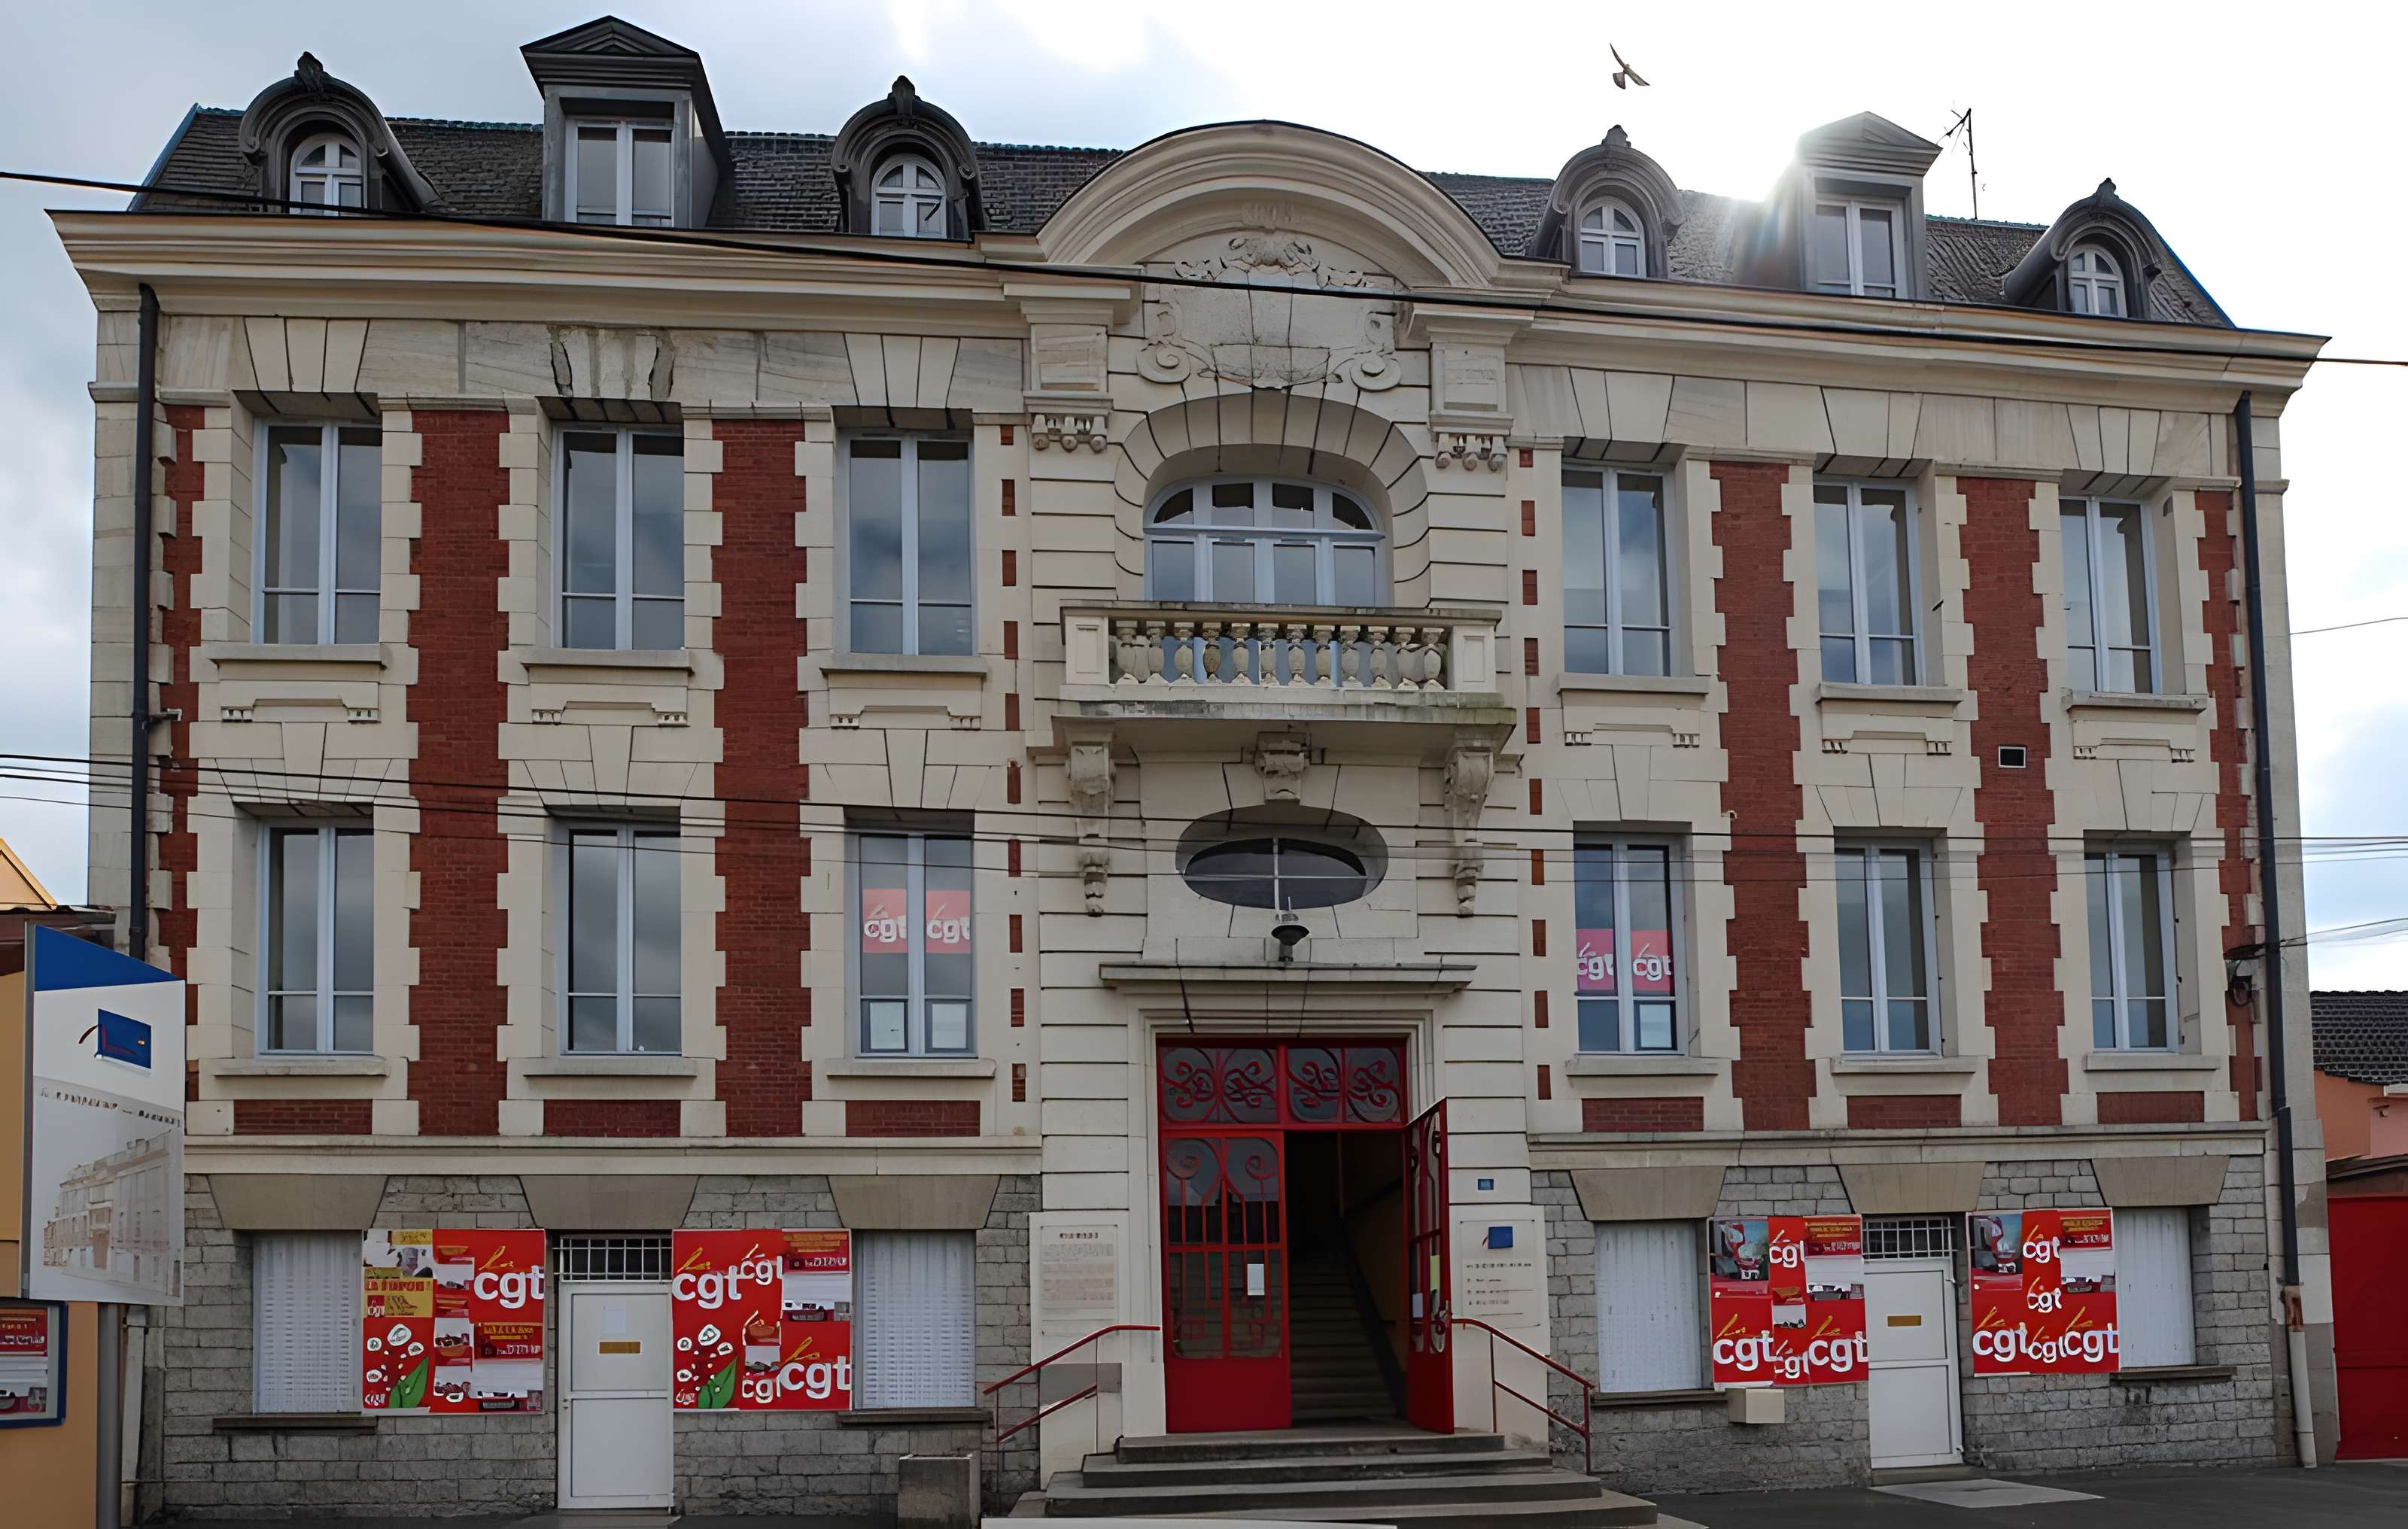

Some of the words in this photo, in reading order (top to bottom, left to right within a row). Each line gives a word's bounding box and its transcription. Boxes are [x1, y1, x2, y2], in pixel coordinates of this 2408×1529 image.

[865, 915, 907, 942] cgt
[926, 916, 970, 944] cgt
[1633, 956, 1671, 980] cgt
[2022, 1236, 2060, 1263] cgt
[474, 1265, 544, 1309] cgt
[671, 1265, 741, 1309] cgt
[1713, 1330, 1779, 1371] cgt
[1809, 1331, 1868, 1372] cgt
[1973, 1322, 2029, 1363] cgt
[2065, 1323, 2119, 1363] cgt
[778, 1356, 852, 1399] cgt
